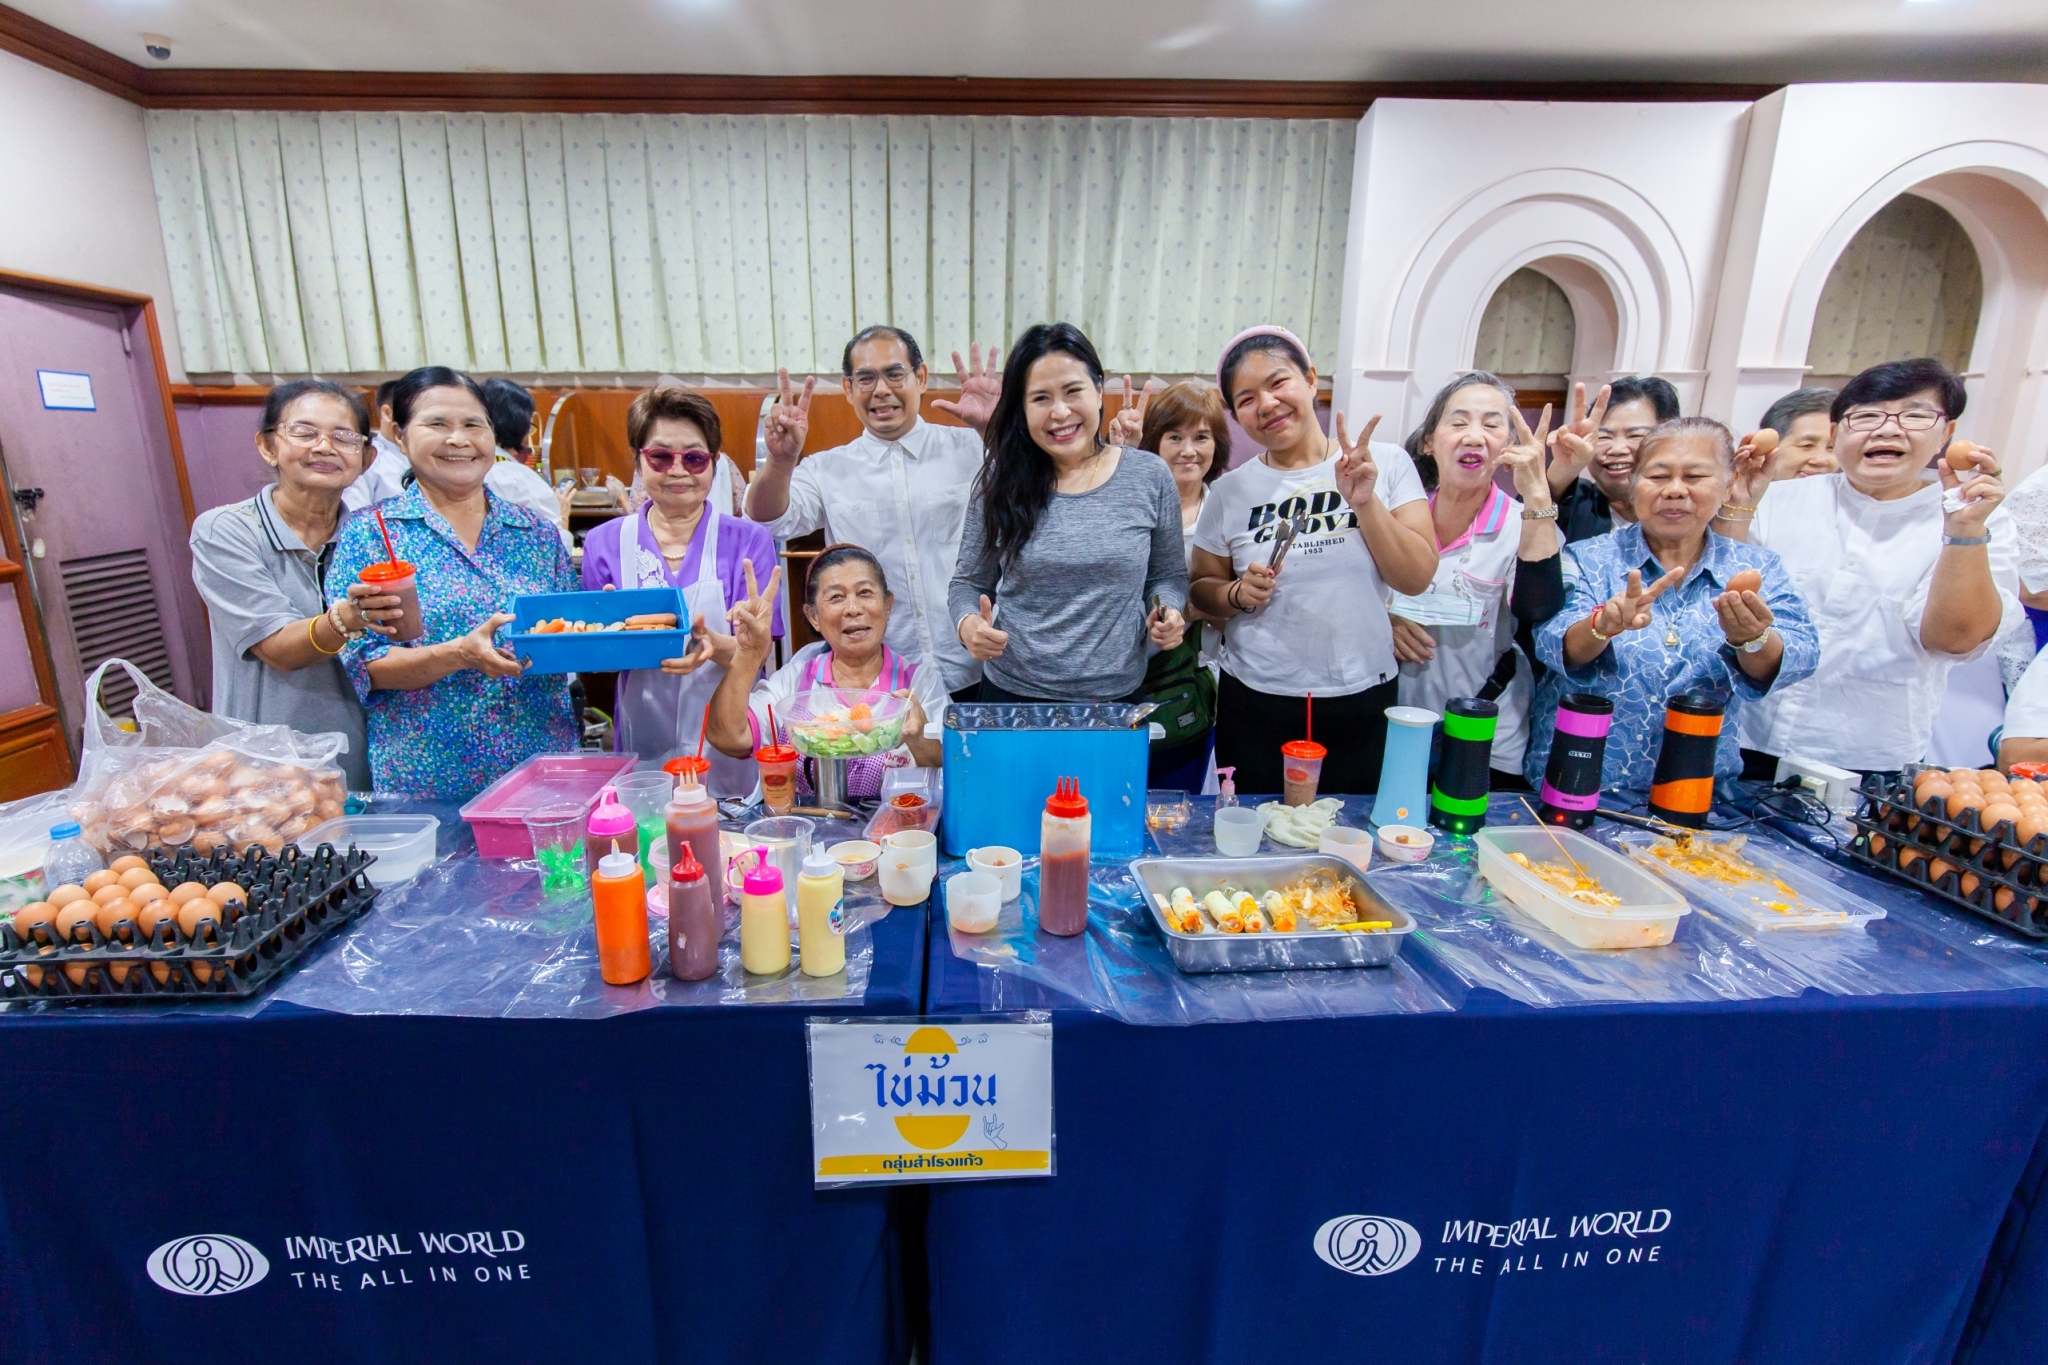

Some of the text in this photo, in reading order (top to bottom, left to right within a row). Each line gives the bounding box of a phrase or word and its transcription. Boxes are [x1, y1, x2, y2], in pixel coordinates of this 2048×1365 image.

[1247, 490, 1352, 531] BOD
[1281, 537, 1345, 549] TABLISHED
[863, 1053, 997, 1108] ไข่ม้วน
[882, 1153, 983, 1173] กลุ่มสำโรงแก้ว
[1441, 1208, 1672, 1248] IMPERIAL WORLD
[285, 1230, 525, 1265] IMPERIAL WORLD
[1434, 1245, 1661, 1276] THE ALL IN ONE
[290, 1264, 531, 1291] THE ALL IN ONE
